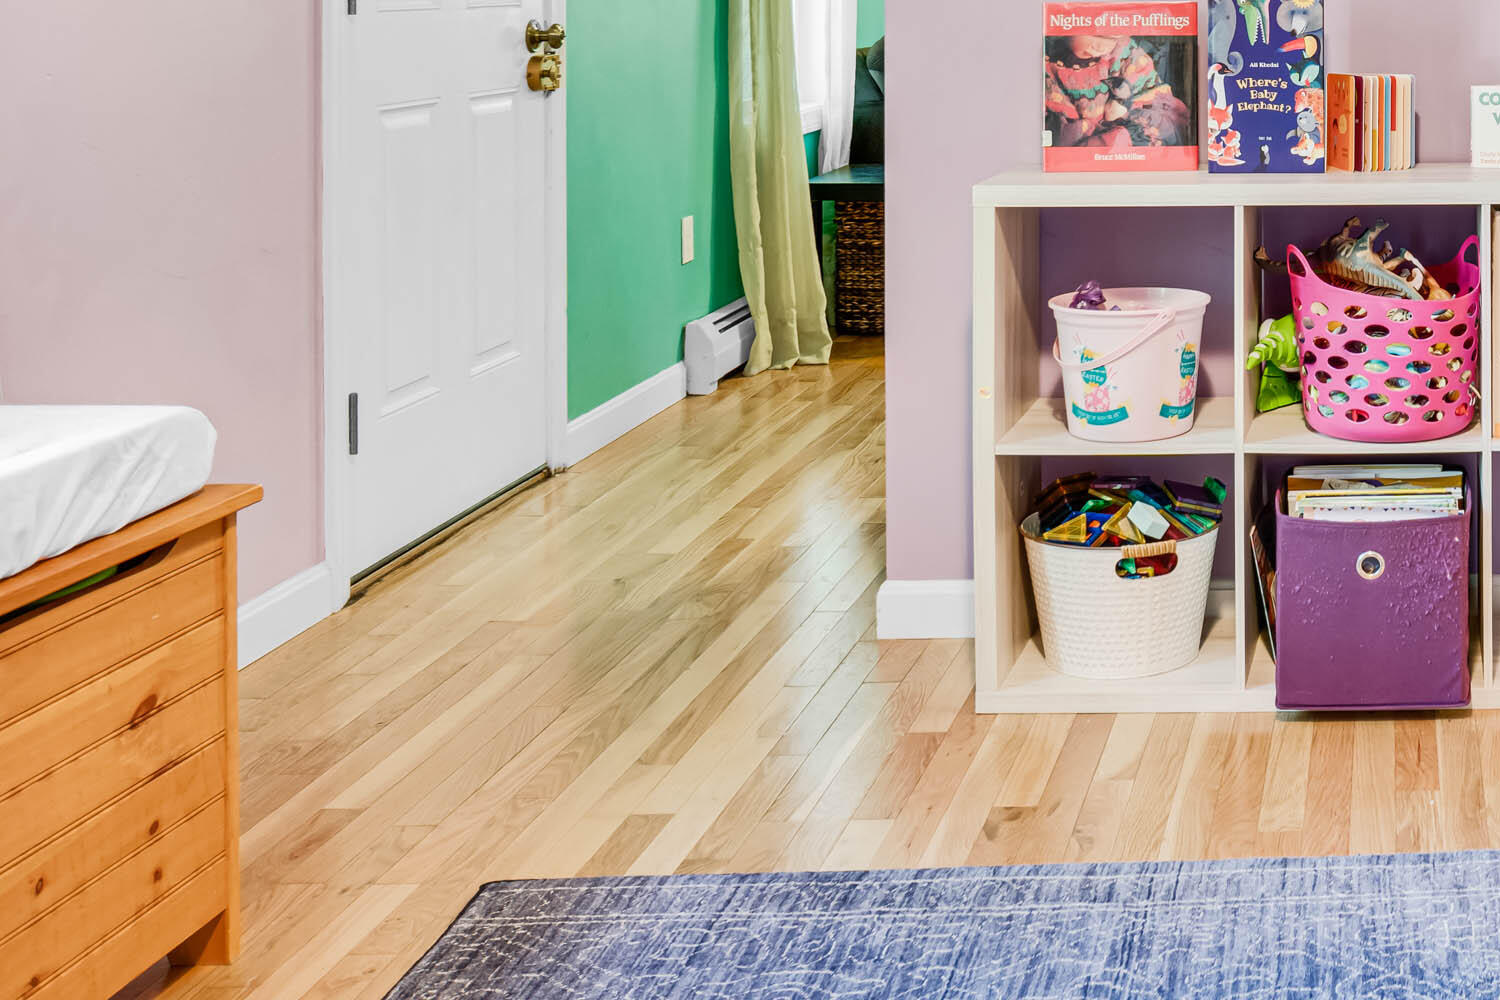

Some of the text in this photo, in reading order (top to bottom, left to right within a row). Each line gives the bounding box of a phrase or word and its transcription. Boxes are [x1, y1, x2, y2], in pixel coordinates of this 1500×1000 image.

[1049, 12, 1190, 30] Nights of the Pufflings
[1236, 77, 1288, 90] Where's
[1249, 89, 1278, 102] Baby
[1237, 101, 1292, 114] Elephant?
